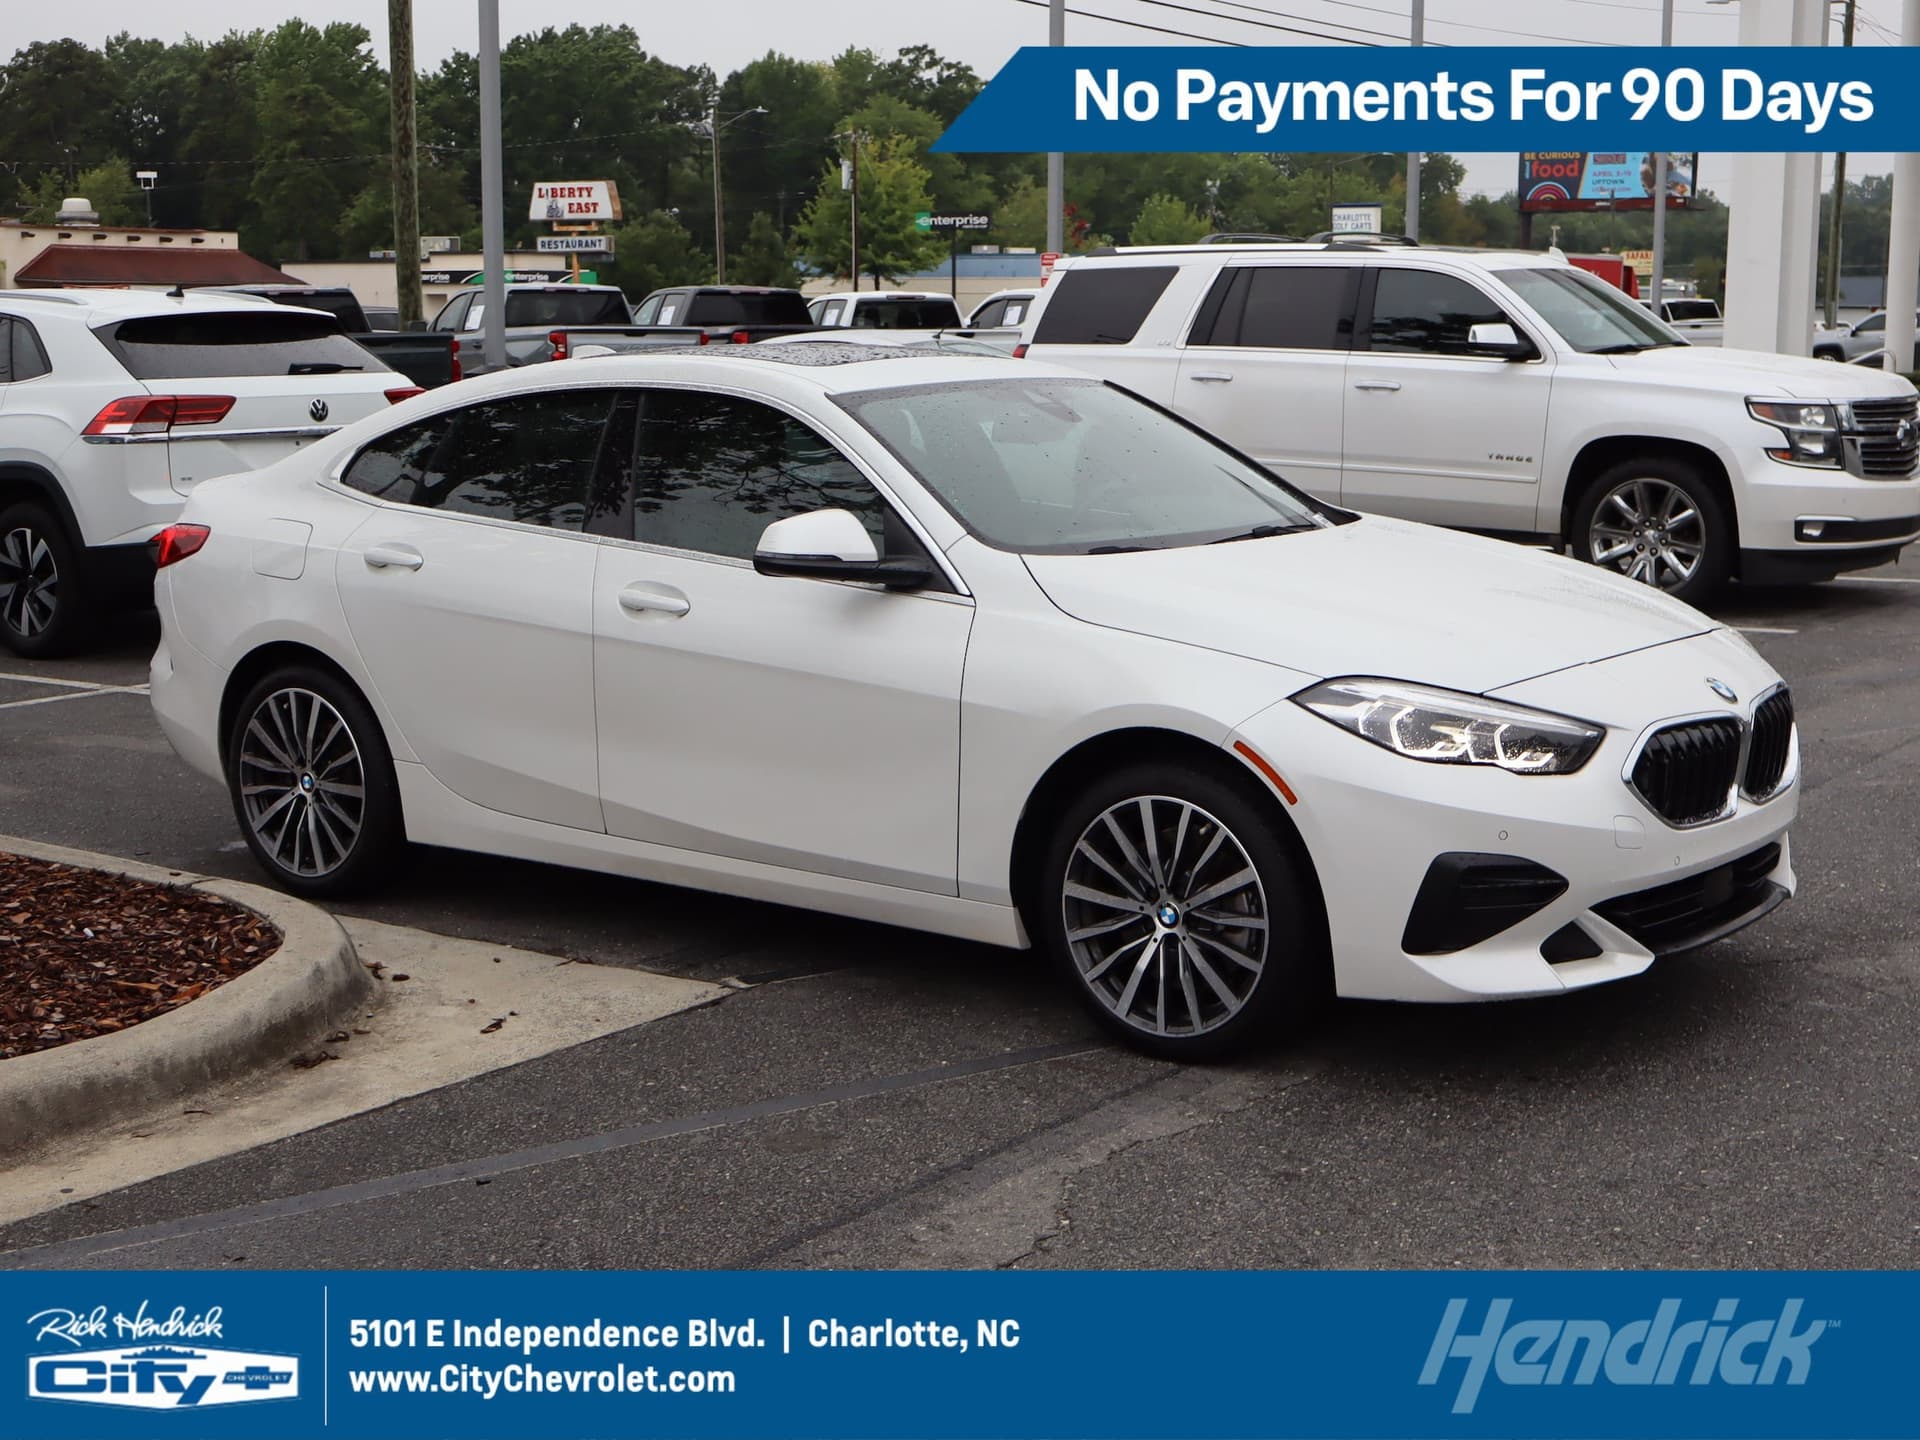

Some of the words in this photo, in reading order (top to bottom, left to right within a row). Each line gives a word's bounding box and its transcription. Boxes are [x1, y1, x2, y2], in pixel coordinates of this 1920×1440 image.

[1532, 160, 1579, 178] food
[538, 187, 593, 199] LIBERTY
[568, 202, 599, 214] EAST
[919, 213, 989, 227] enterprise
[540, 239, 602, 250] RESTAURANT
